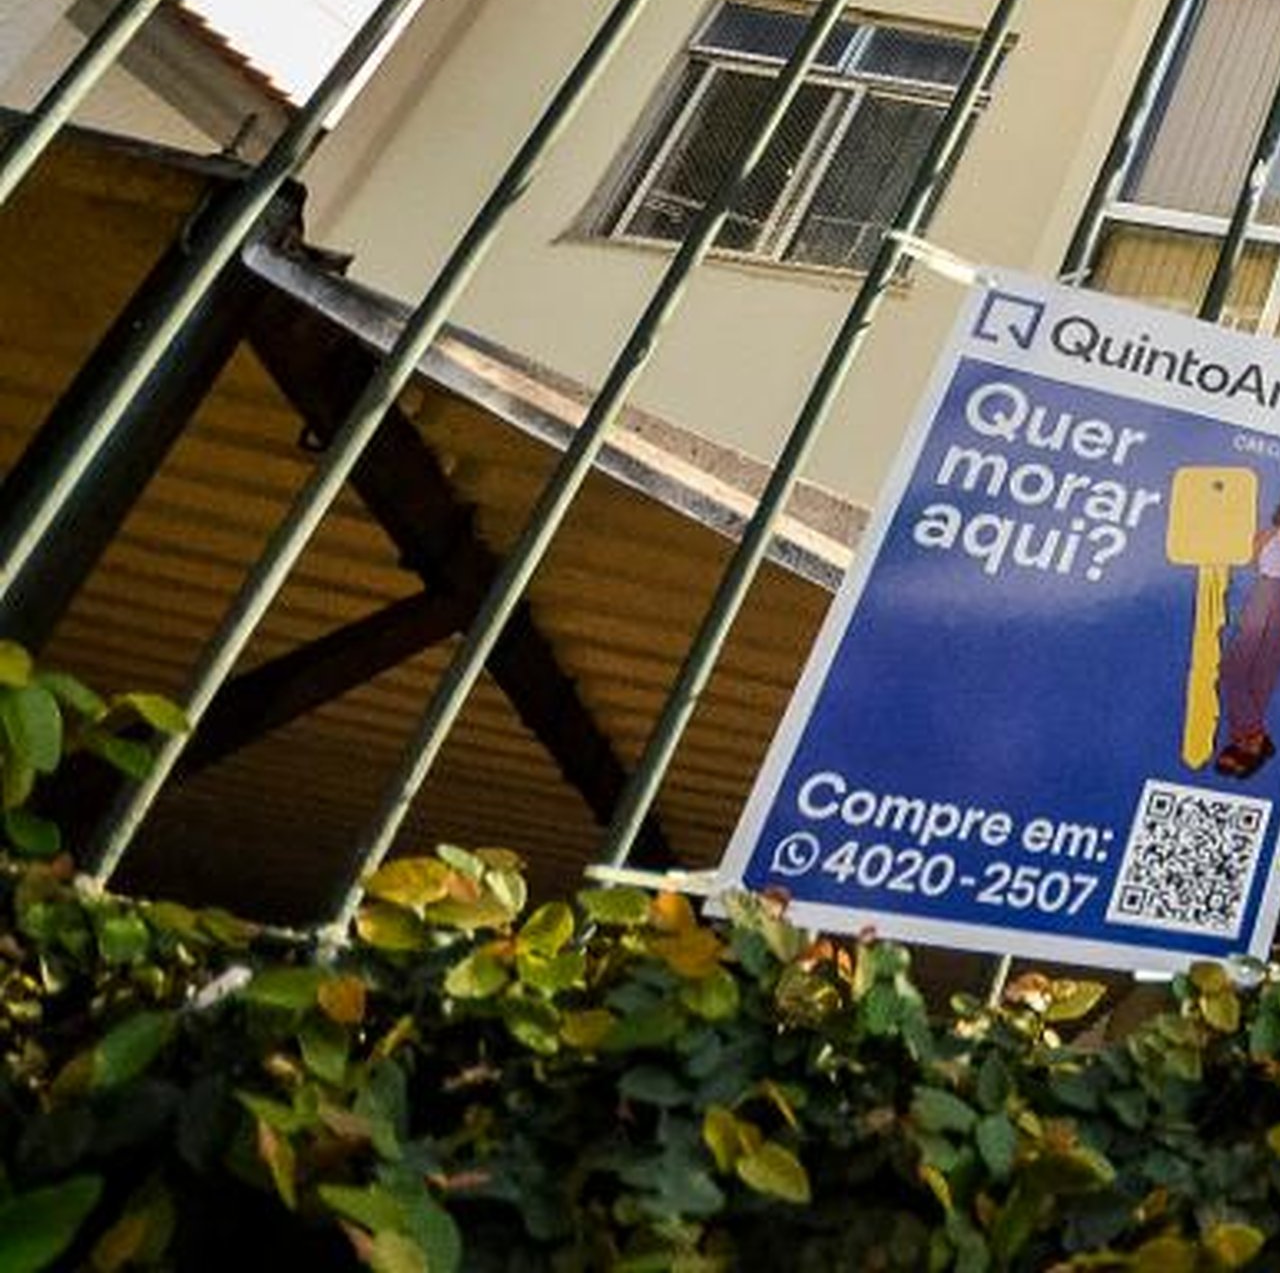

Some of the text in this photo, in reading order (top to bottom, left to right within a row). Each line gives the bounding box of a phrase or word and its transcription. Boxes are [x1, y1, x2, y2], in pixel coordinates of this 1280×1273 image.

[964, 383, 1147, 467] Quer
[934, 444, 1161, 528] morar
[913, 502, 1127, 581] aqui?
[797, 772, 1114, 861] Compre em:
[822, 840, 1097, 916] 4020-2507
